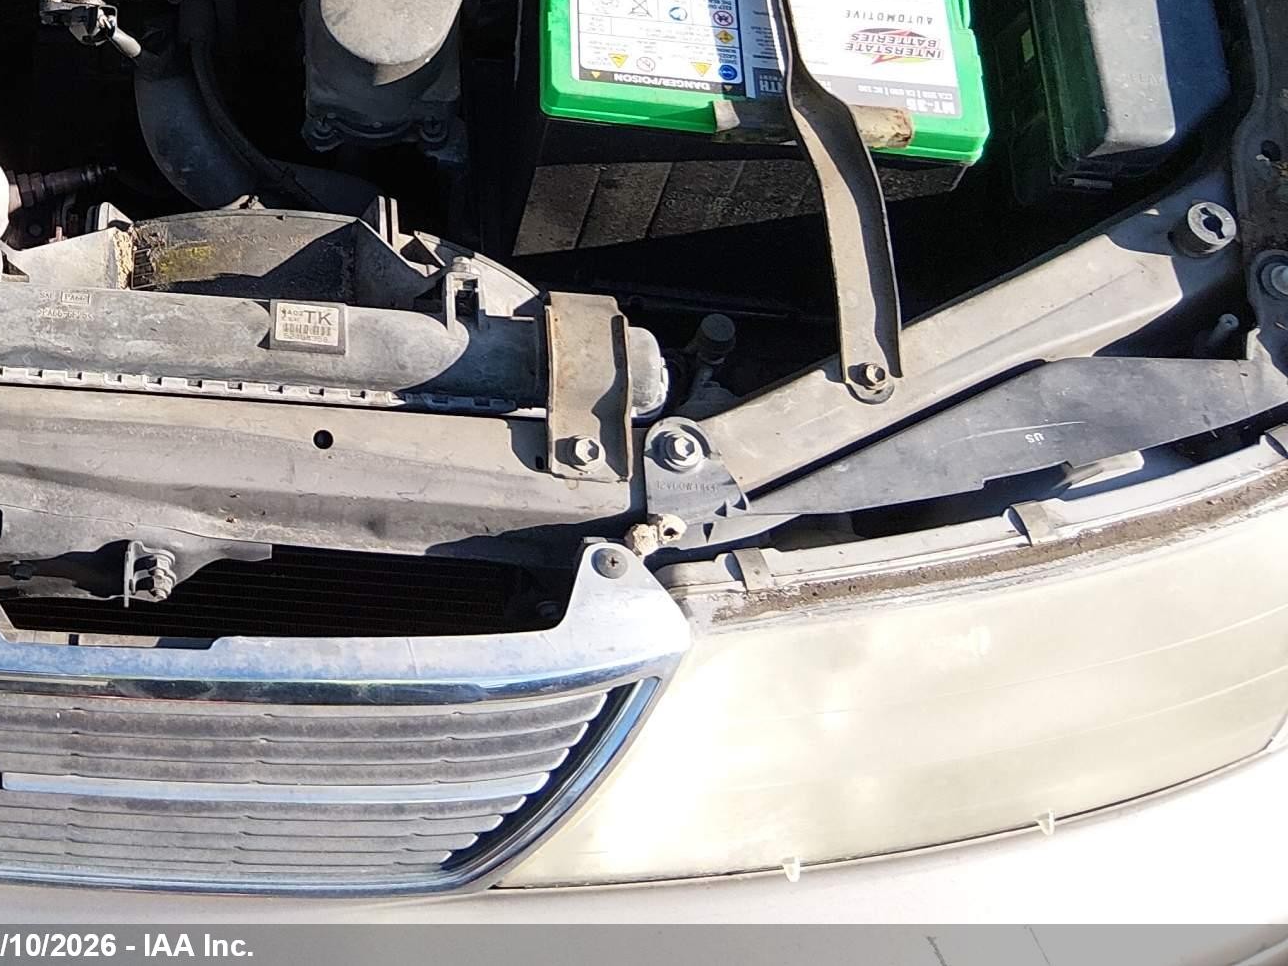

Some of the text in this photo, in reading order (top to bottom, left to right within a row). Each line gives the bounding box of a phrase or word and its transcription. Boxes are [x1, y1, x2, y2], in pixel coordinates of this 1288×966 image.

[845, 10, 933, 25] AUTOMOTIVE
[851, 33, 937, 48] BATTERIES
[845, 43, 942, 59] INTERSTATE
[613, 73, 710, 91] DANGER/POISON
[304, 310, 332, 326] TK
[1024, 432, 1045, 443] US
